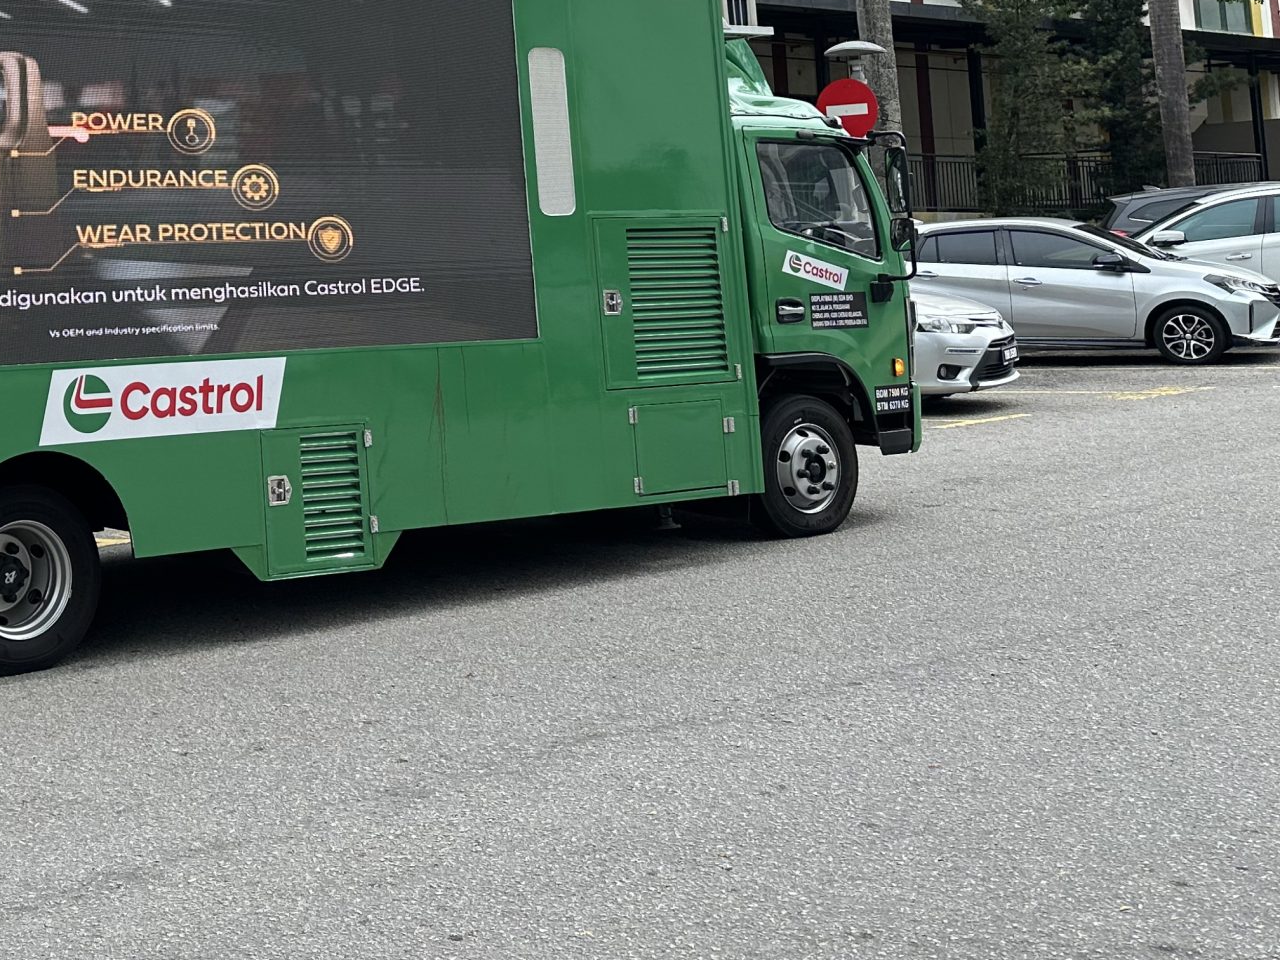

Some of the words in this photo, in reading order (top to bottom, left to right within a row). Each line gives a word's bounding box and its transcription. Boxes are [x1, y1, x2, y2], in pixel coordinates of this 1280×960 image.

[71, 111, 164, 131] POWER
[73, 169, 228, 188] ENDURANCE
[76, 223, 151, 243] WEAR
[158, 221, 306, 242] PROTECTION
[803, 261, 843, 284] Castrol
[111, 284, 167, 303] untuk
[171, 280, 300, 303] menghasilkan
[303, 278, 366, 296] Castrol
[370, 277, 425, 294] EDGE.
[49, 329, 61, 338] Vs
[62, 328, 84, 338] OEM
[85, 327, 103, 336] and
[104, 326, 140, 335] Industry
[141, 323, 194, 334] specification
[120, 373, 264, 421] Castrol
[900, 386, 909, 396] KG
[901, 399, 909, 409] KG
